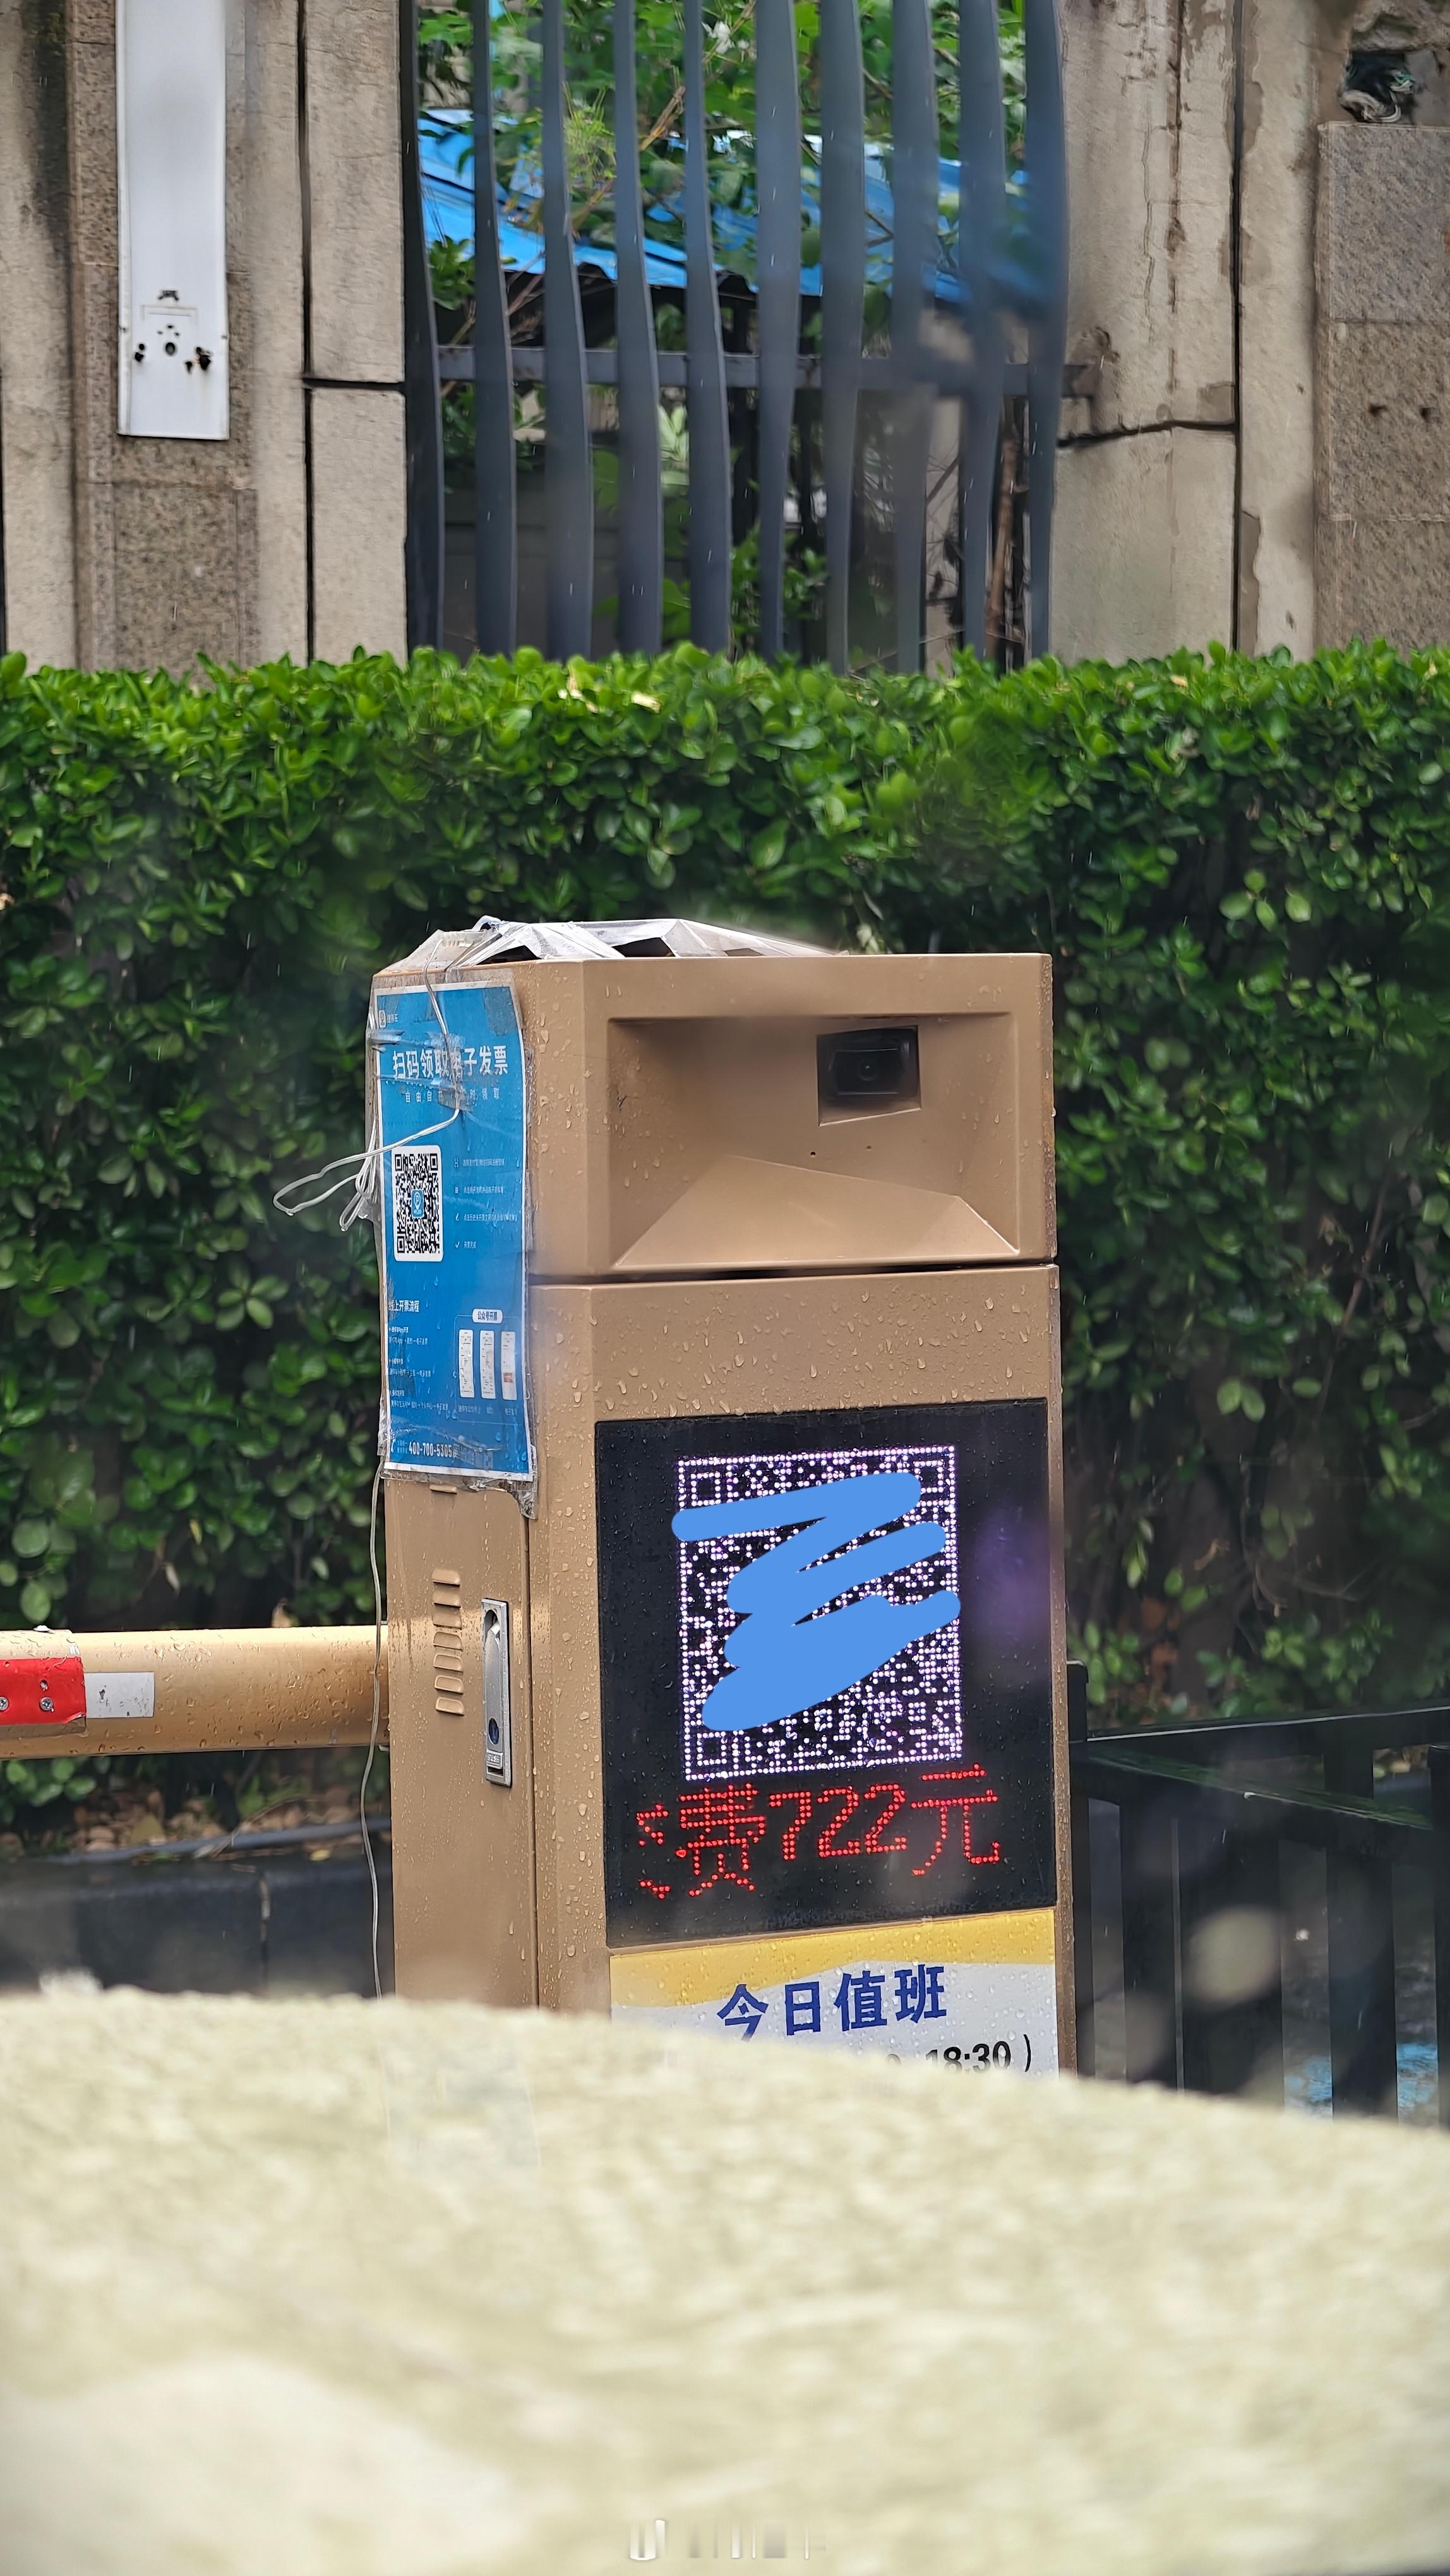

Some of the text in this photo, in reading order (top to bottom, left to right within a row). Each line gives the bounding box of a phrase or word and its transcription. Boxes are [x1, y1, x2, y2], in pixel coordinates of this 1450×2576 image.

[393, 1045, 508, 1080] 扫码领取子发票
[409, 1441, 453, 1458] 400-700-5305
[717, 1964, 947, 2041] 今日值班
